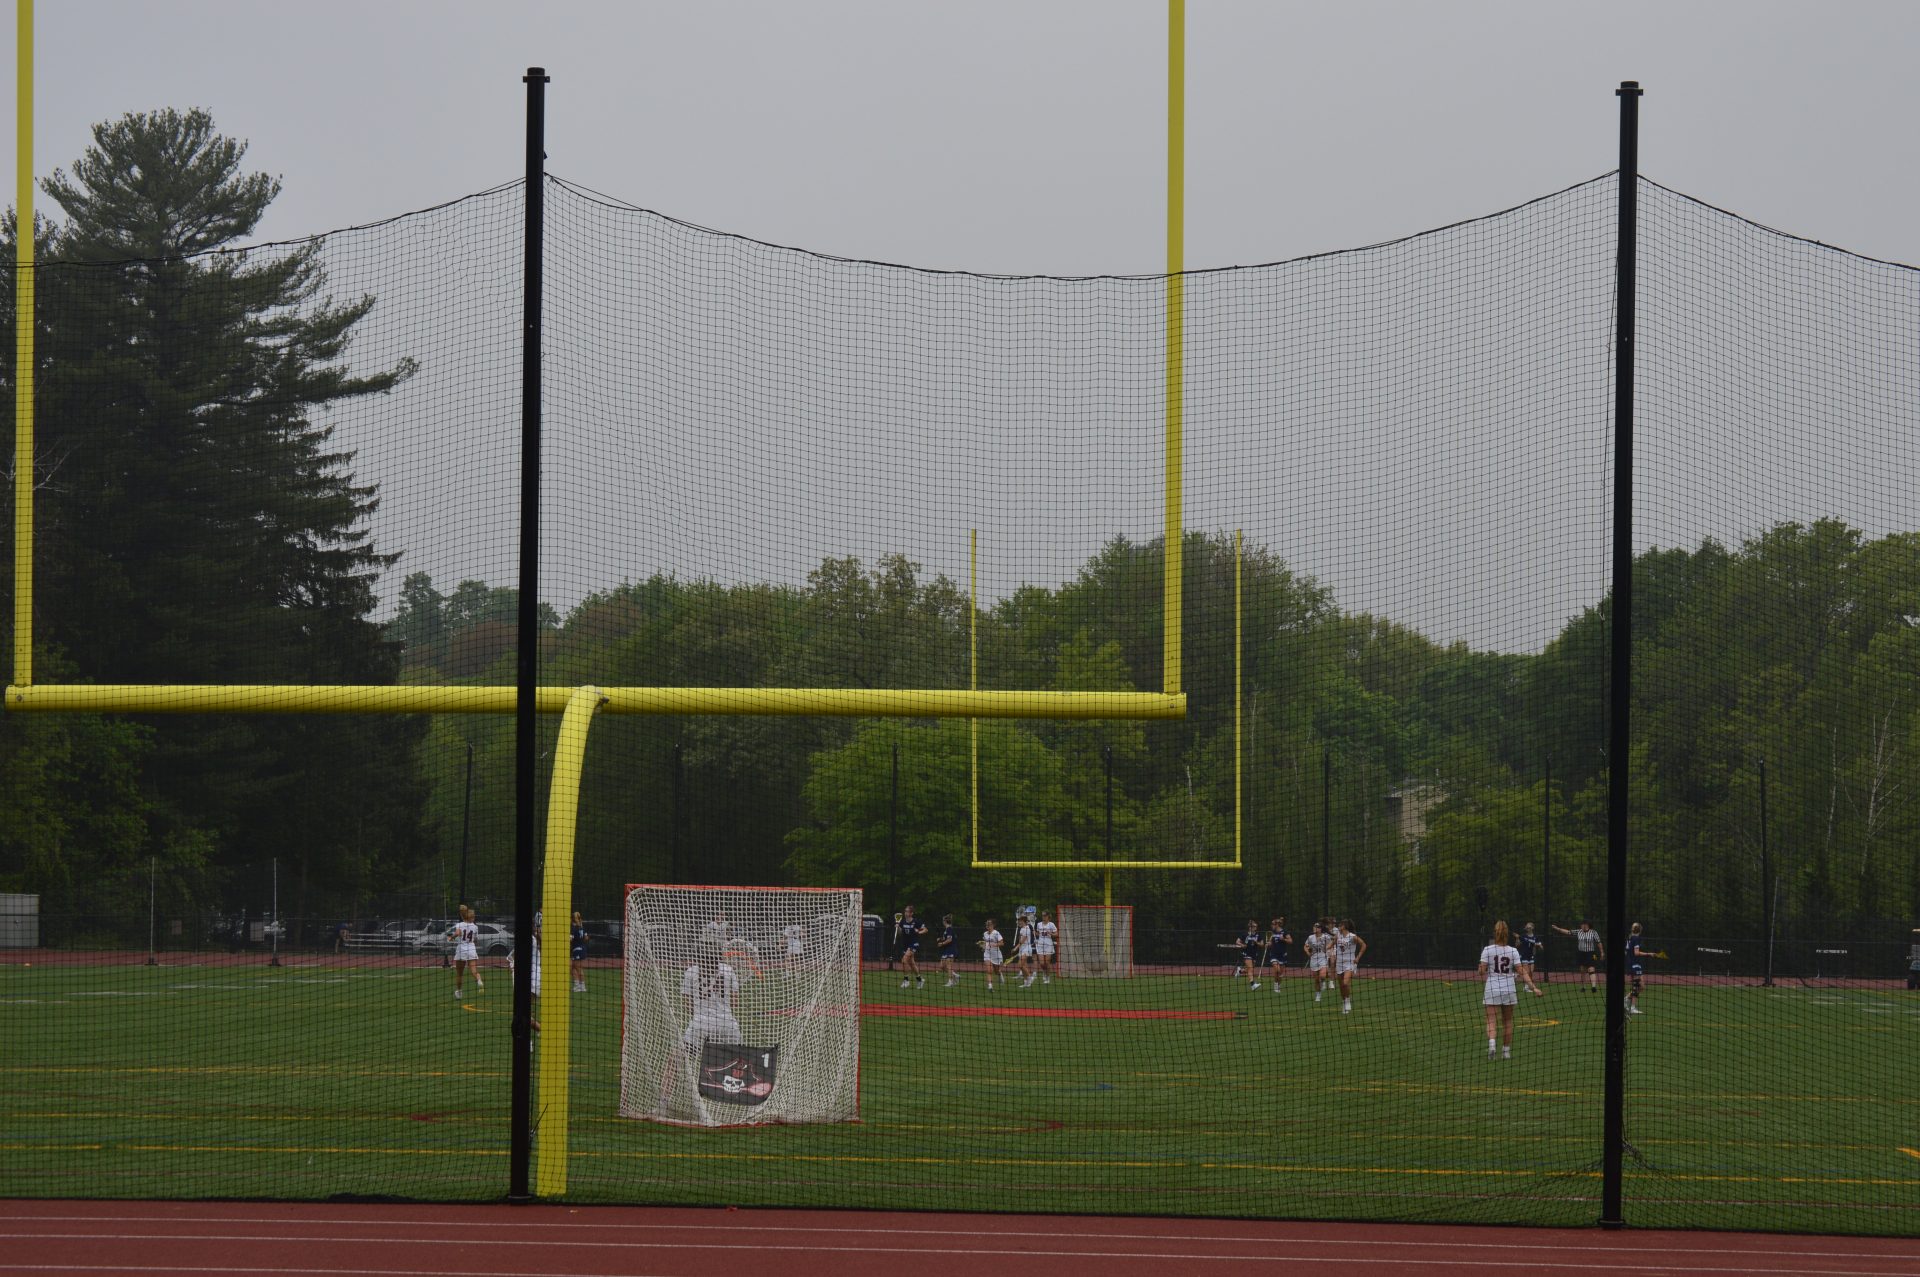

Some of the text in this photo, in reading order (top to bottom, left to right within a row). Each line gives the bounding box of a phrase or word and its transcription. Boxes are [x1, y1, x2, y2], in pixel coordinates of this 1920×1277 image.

[462, 929, 474, 942] 14
[1493, 955, 1511, 974] 12
[761, 1053, 770, 1068] 1
